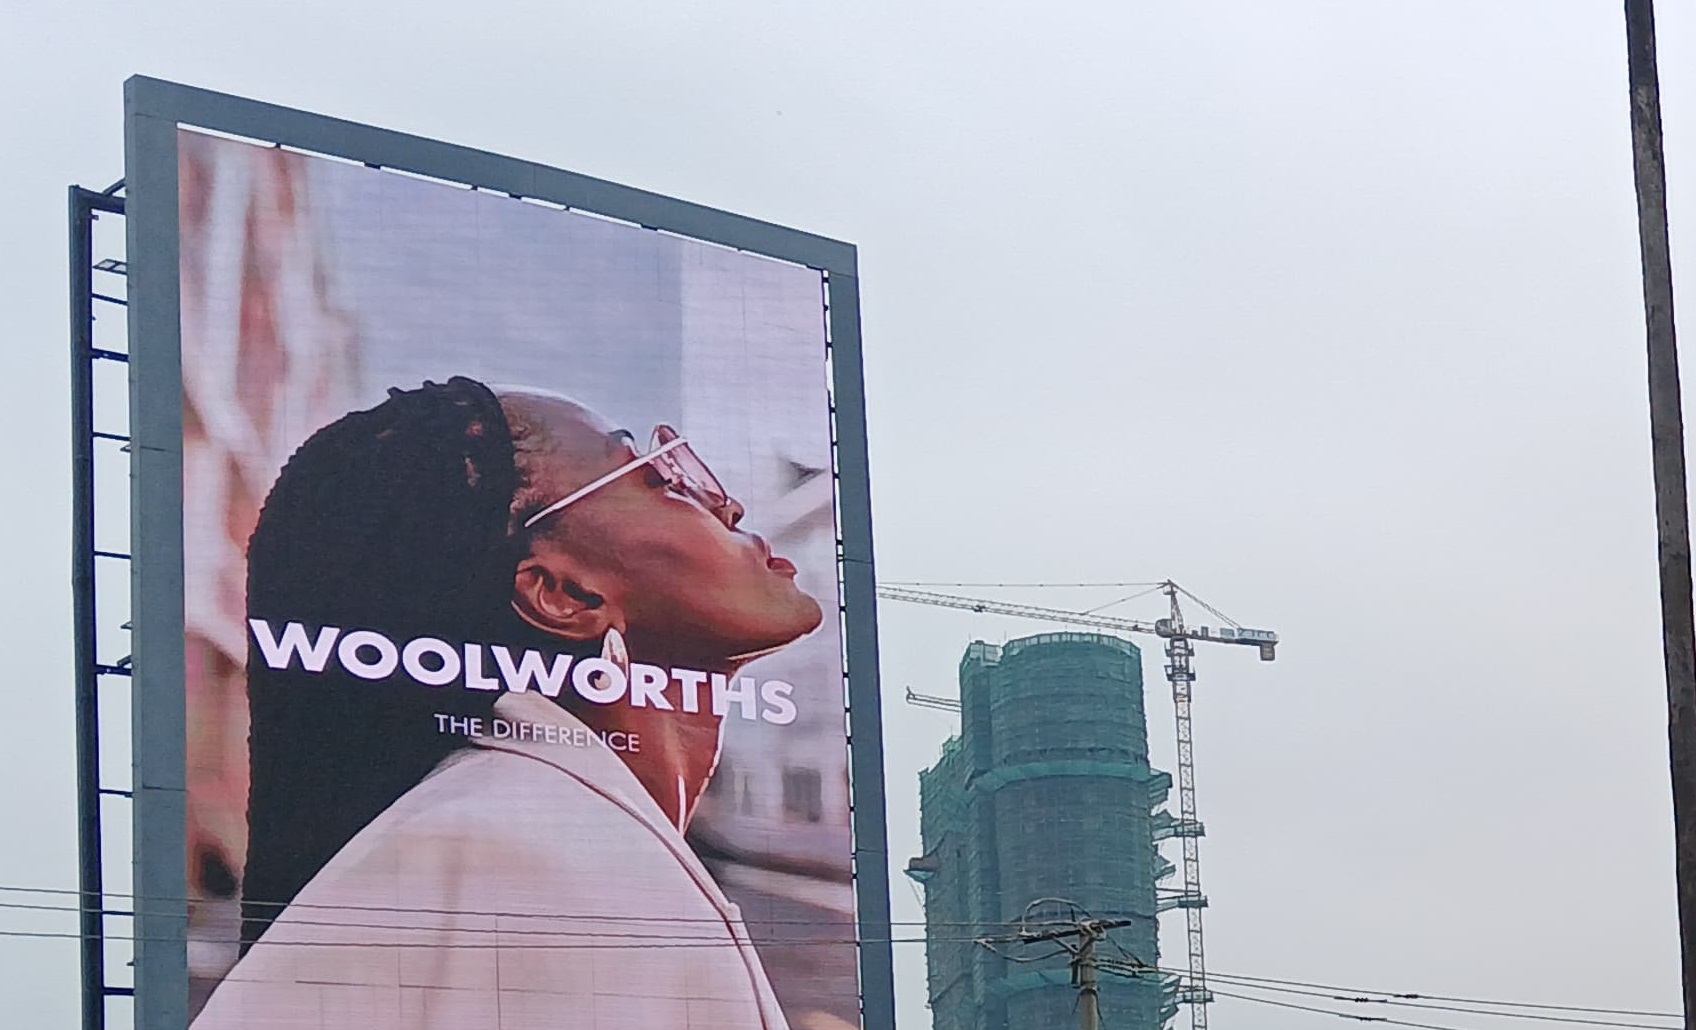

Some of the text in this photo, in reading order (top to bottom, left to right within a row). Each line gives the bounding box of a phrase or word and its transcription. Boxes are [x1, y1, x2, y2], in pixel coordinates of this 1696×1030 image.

[249, 618, 798, 726] WOOLWORTHS
[434, 713, 641, 753] THE DIFFERENCE
